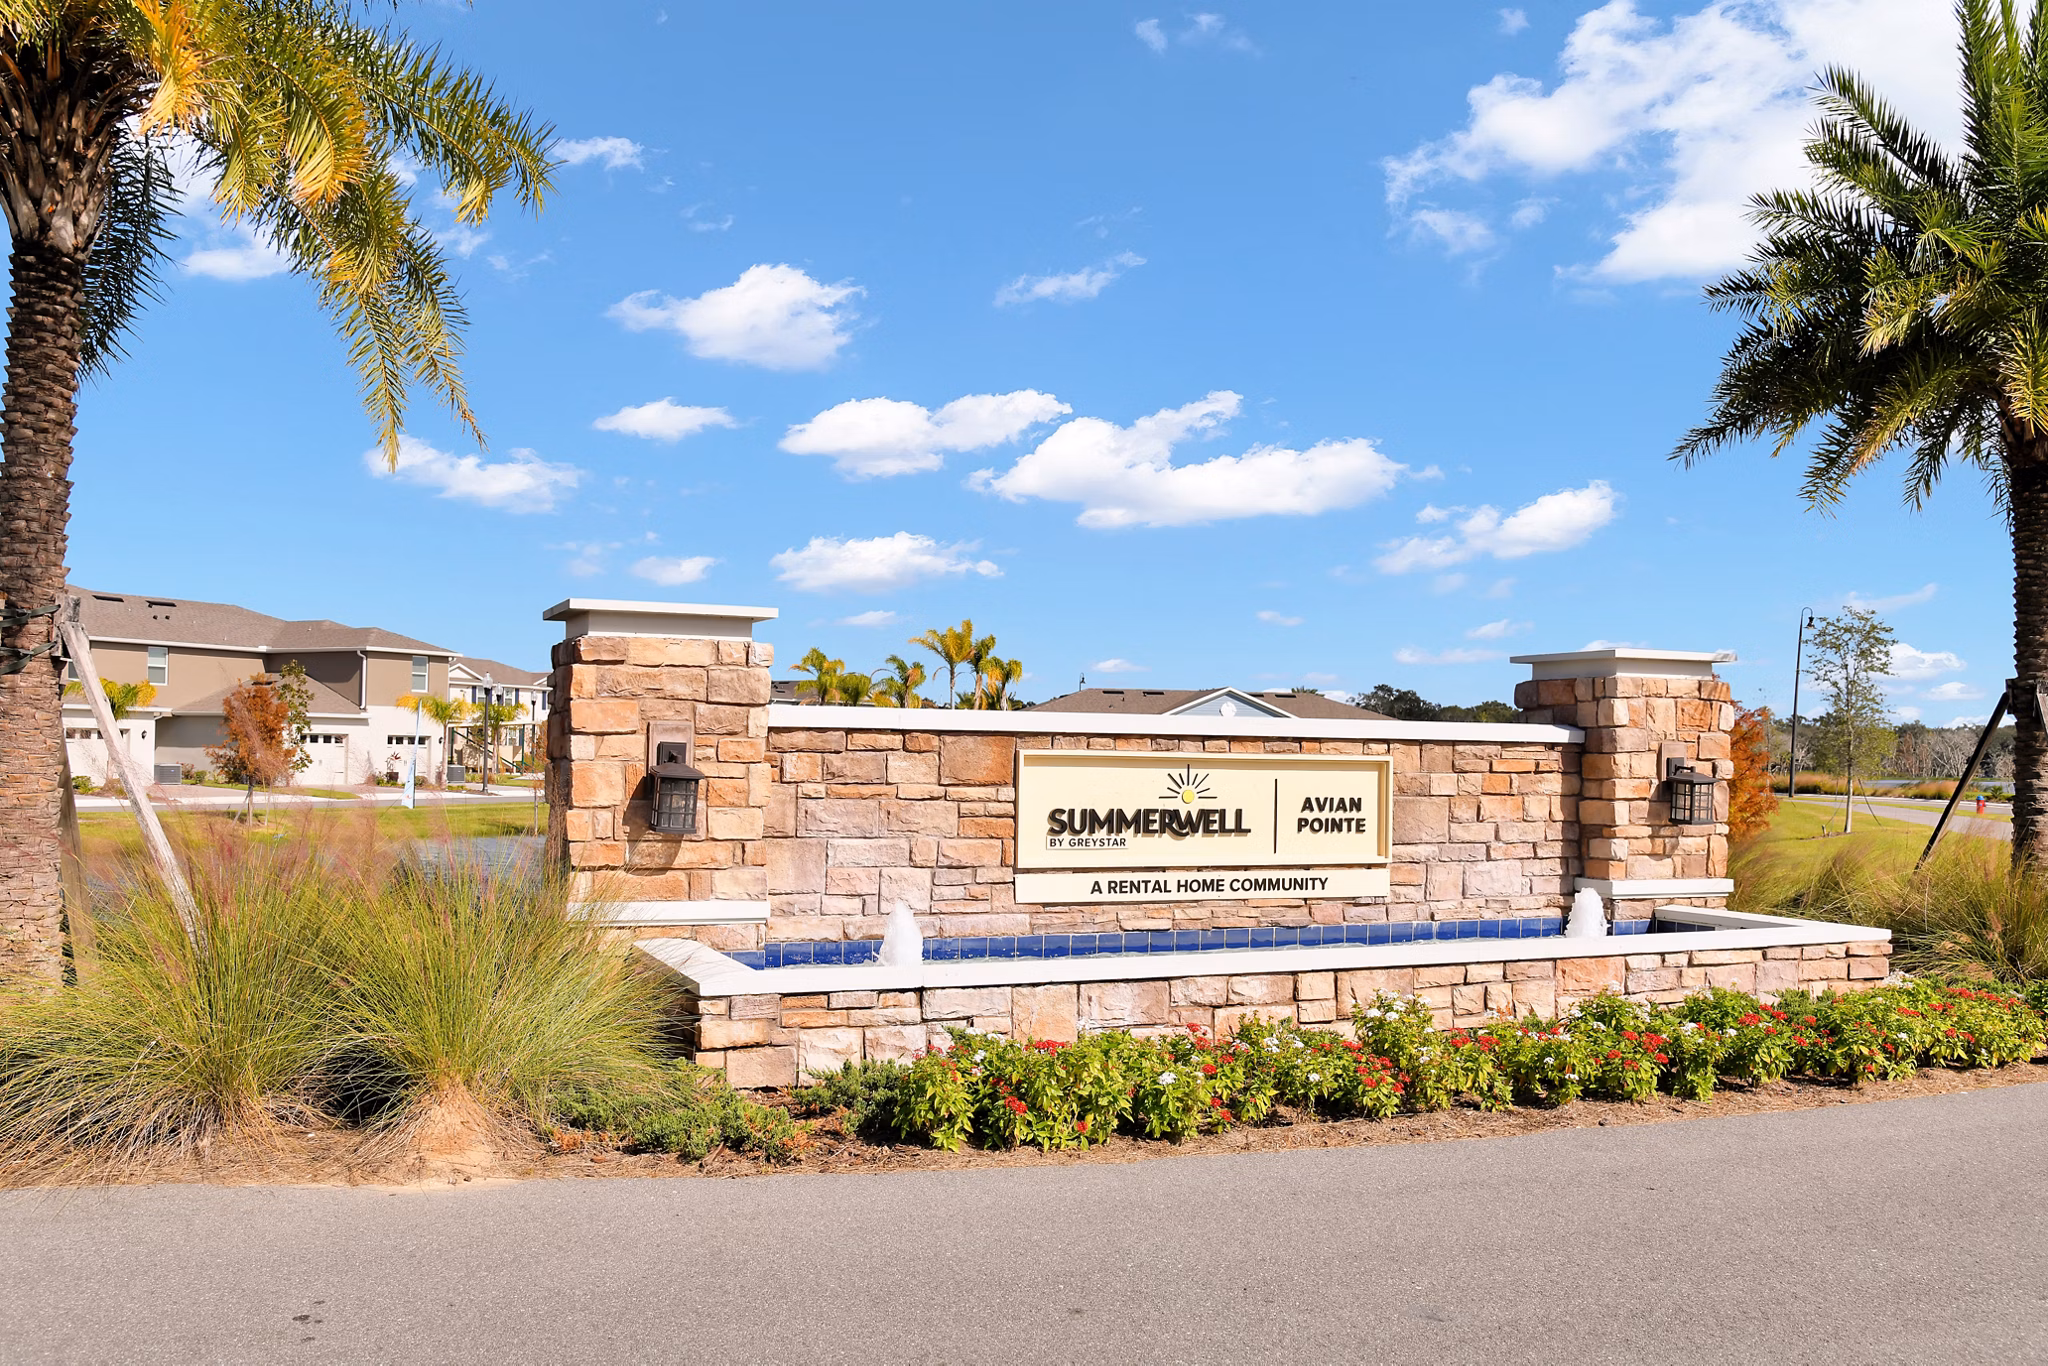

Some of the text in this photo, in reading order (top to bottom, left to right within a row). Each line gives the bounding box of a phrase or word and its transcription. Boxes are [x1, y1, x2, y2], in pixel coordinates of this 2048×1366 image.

[1301, 797, 1362, 813] AVIAN
[1047, 808, 1251, 837] SUMMERWELL
[1297, 818, 1366, 834] POINTE
[1049, 838, 1126, 847] BY GREYSTAR
[1090, 878, 1328, 894] A RENTAL HOME COMMUNITY
